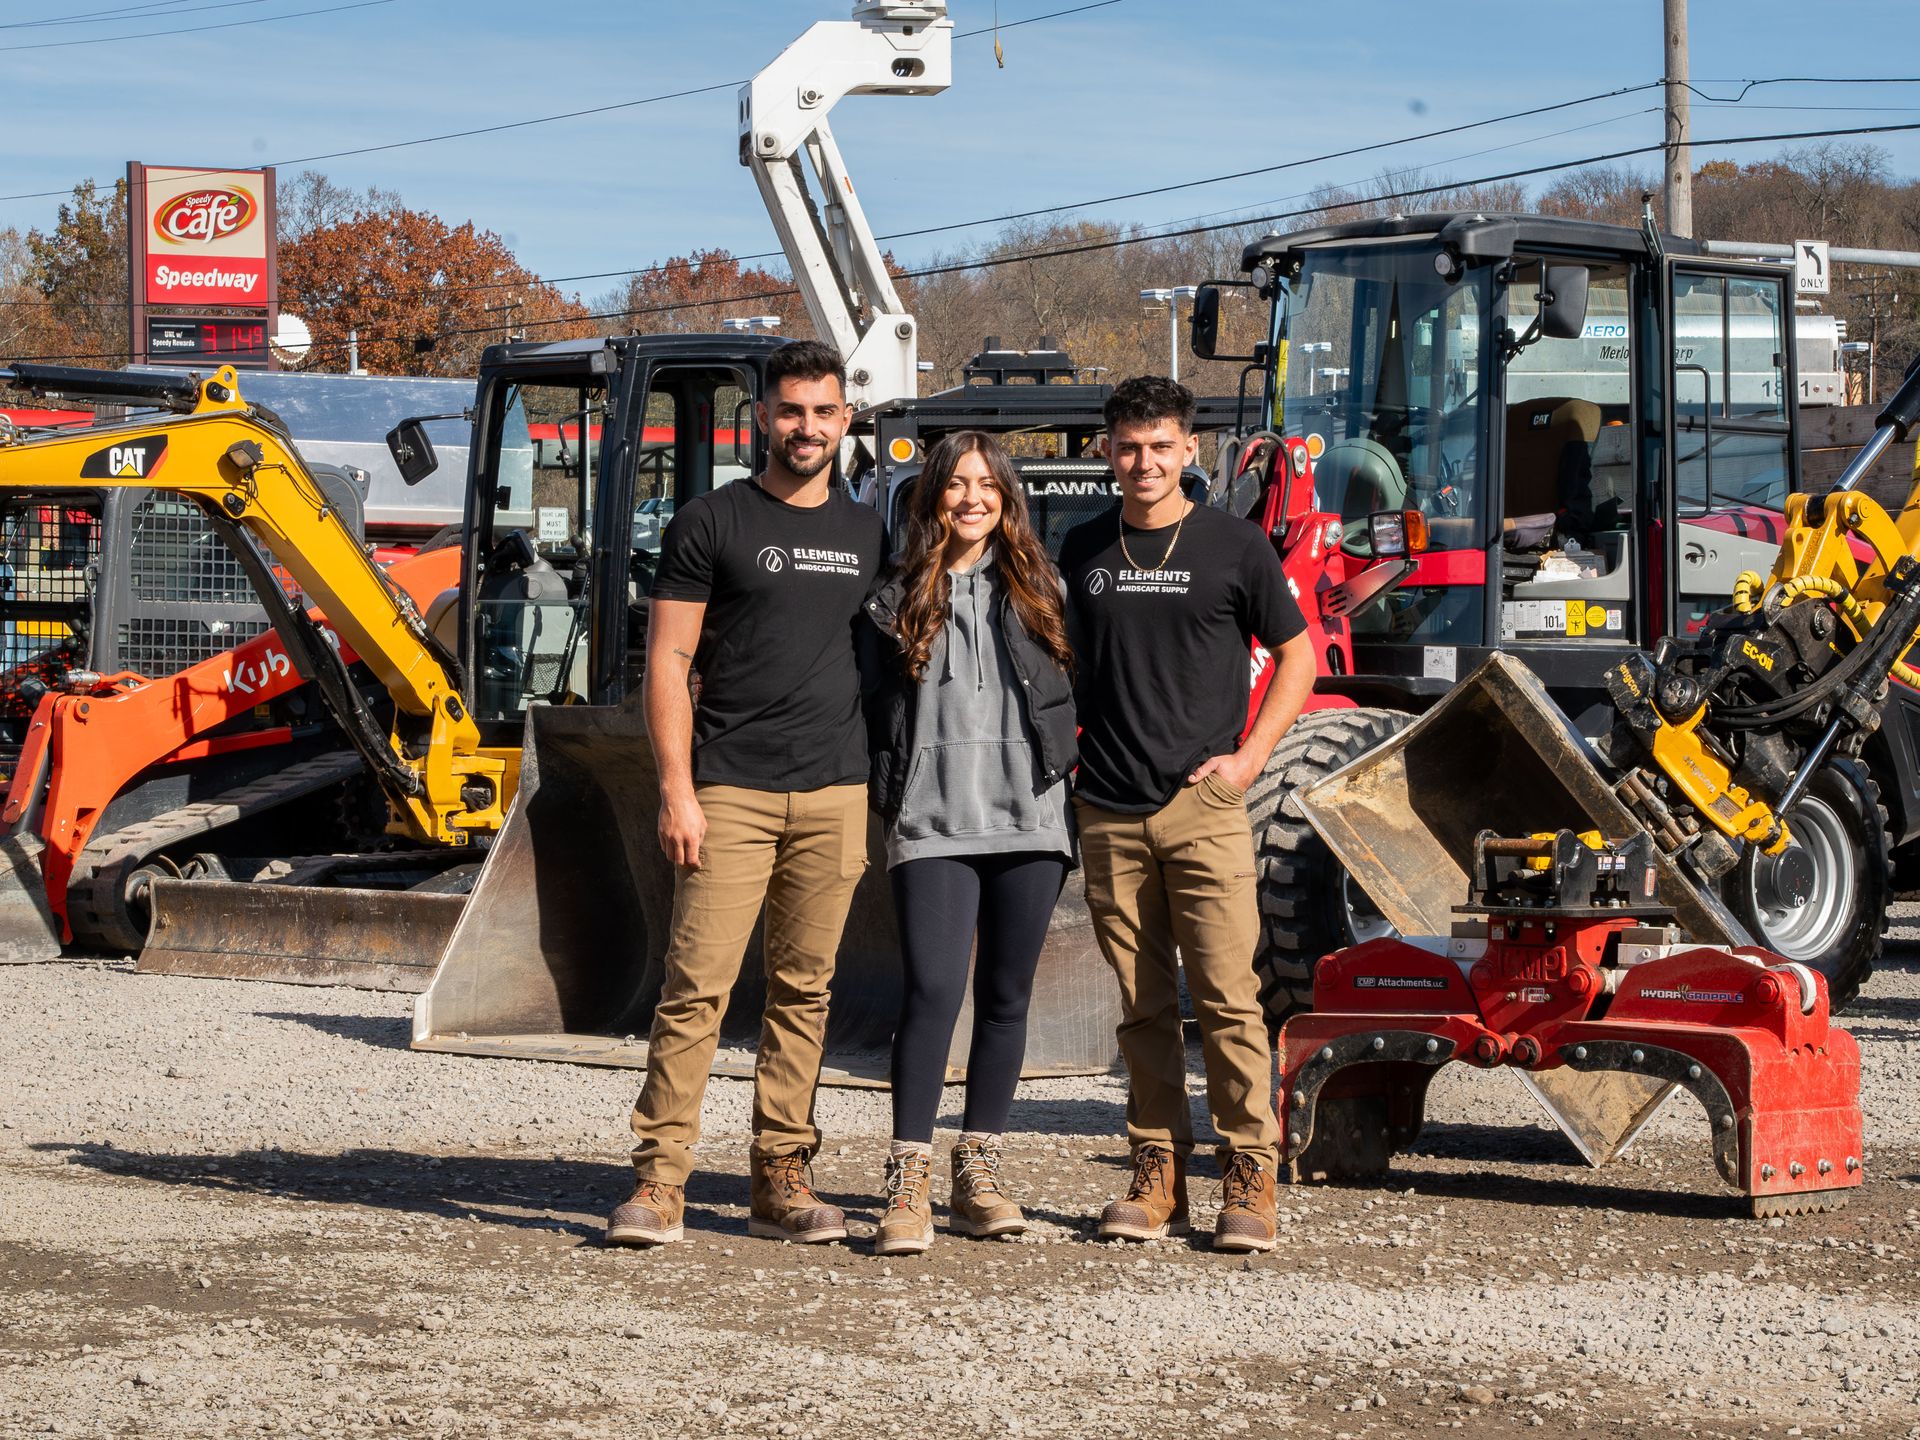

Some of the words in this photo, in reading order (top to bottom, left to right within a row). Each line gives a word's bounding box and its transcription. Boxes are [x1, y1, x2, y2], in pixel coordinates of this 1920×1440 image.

[185, 193, 213, 206] Speedy
[155, 265, 258, 292] Speedway
[1800, 278, 1824, 288] ONLY
[1584, 325, 1626, 337] AERO
[152, 339, 172, 347] Speedy
[1599, 345, 1629, 360] Merlo
[1533, 414, 1549, 426] CAT
[109, 447, 146, 476] CAT
[1027, 481, 1107, 496] LAWN
[793, 548, 859, 565] ELEMENTS
[794, 563, 836, 573] LANDSCAPE
[836, 566, 860, 576] SUPPLY
[1118, 569, 1191, 582] ELEMENTS
[1116, 585, 1160, 593] LANDSCAPE
[1161, 586, 1189, 594] SUPPLY
[1742, 640, 1774, 673] EC-Oil
[1618, 664, 1642, 698] engcon
[1686, 991, 1744, 1003] GRAPPLE
